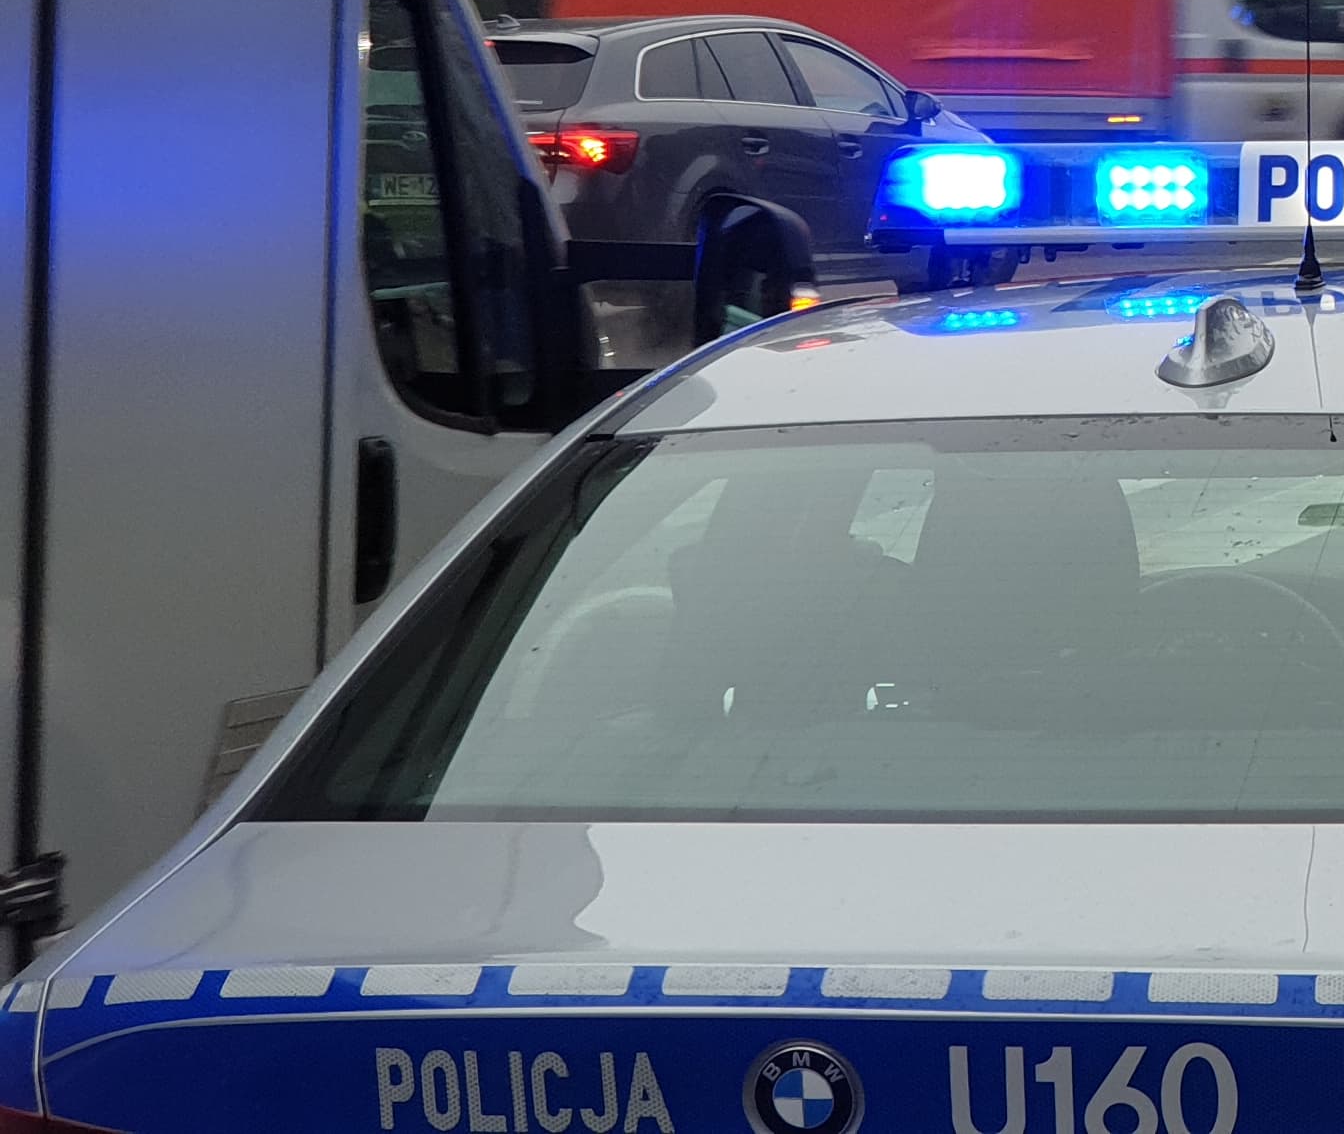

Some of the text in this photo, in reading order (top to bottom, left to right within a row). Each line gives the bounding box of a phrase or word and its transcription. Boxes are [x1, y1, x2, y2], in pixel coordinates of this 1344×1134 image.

[375, 1047, 676, 1134] POLICJA
[762, 1051, 847, 1083] BMW
[948, 1041, 1239, 1134] U160
